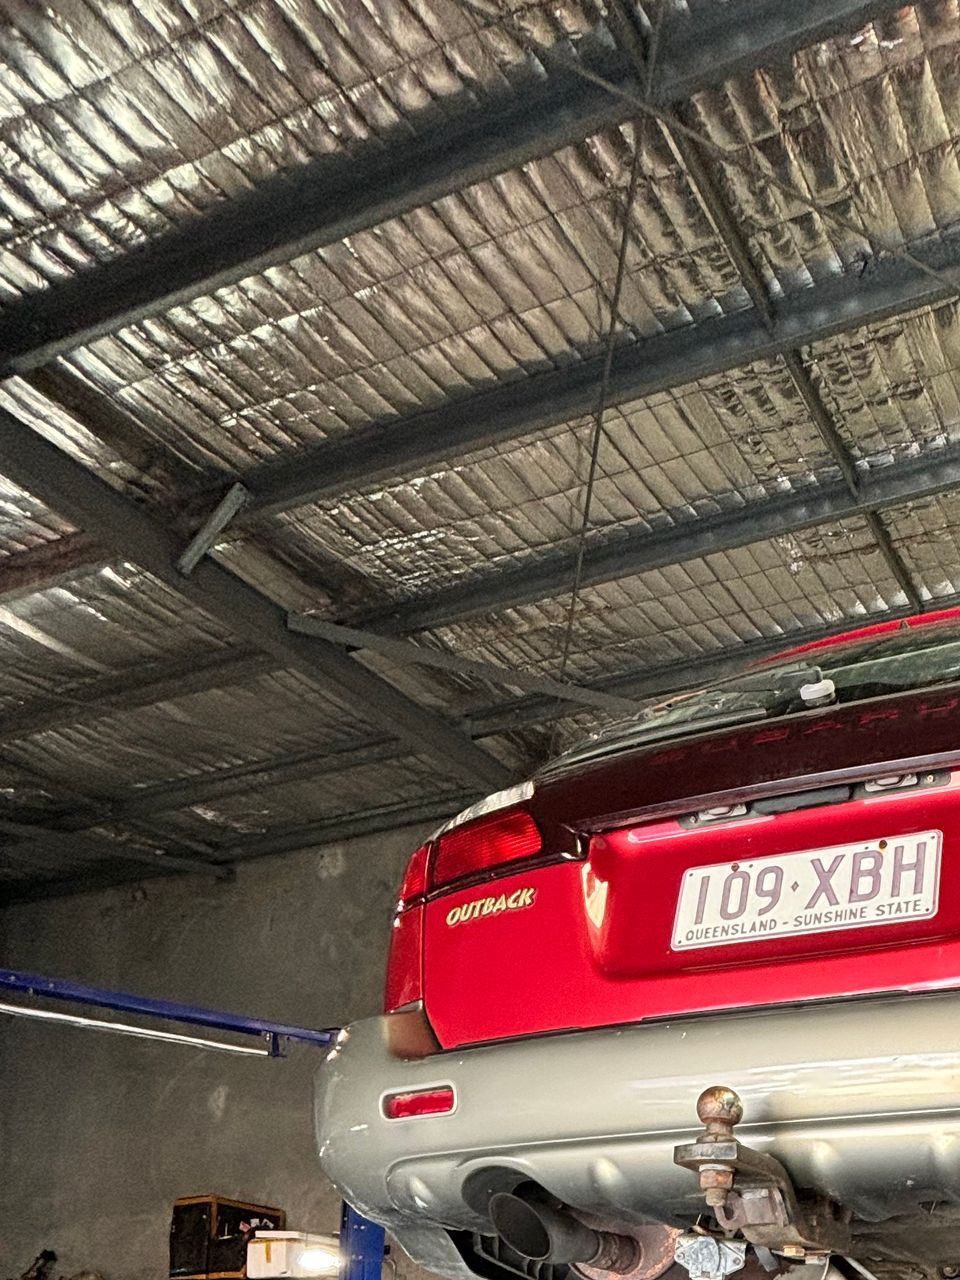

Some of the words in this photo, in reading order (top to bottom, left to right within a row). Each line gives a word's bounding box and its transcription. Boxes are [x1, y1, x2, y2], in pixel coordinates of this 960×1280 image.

[446, 888, 535, 926] OUTBACK
[685, 918, 777, 942] QUEENSLAND
[793, 906, 867, 927] SUNSHINE
[875, 899, 922, 917] STATE
